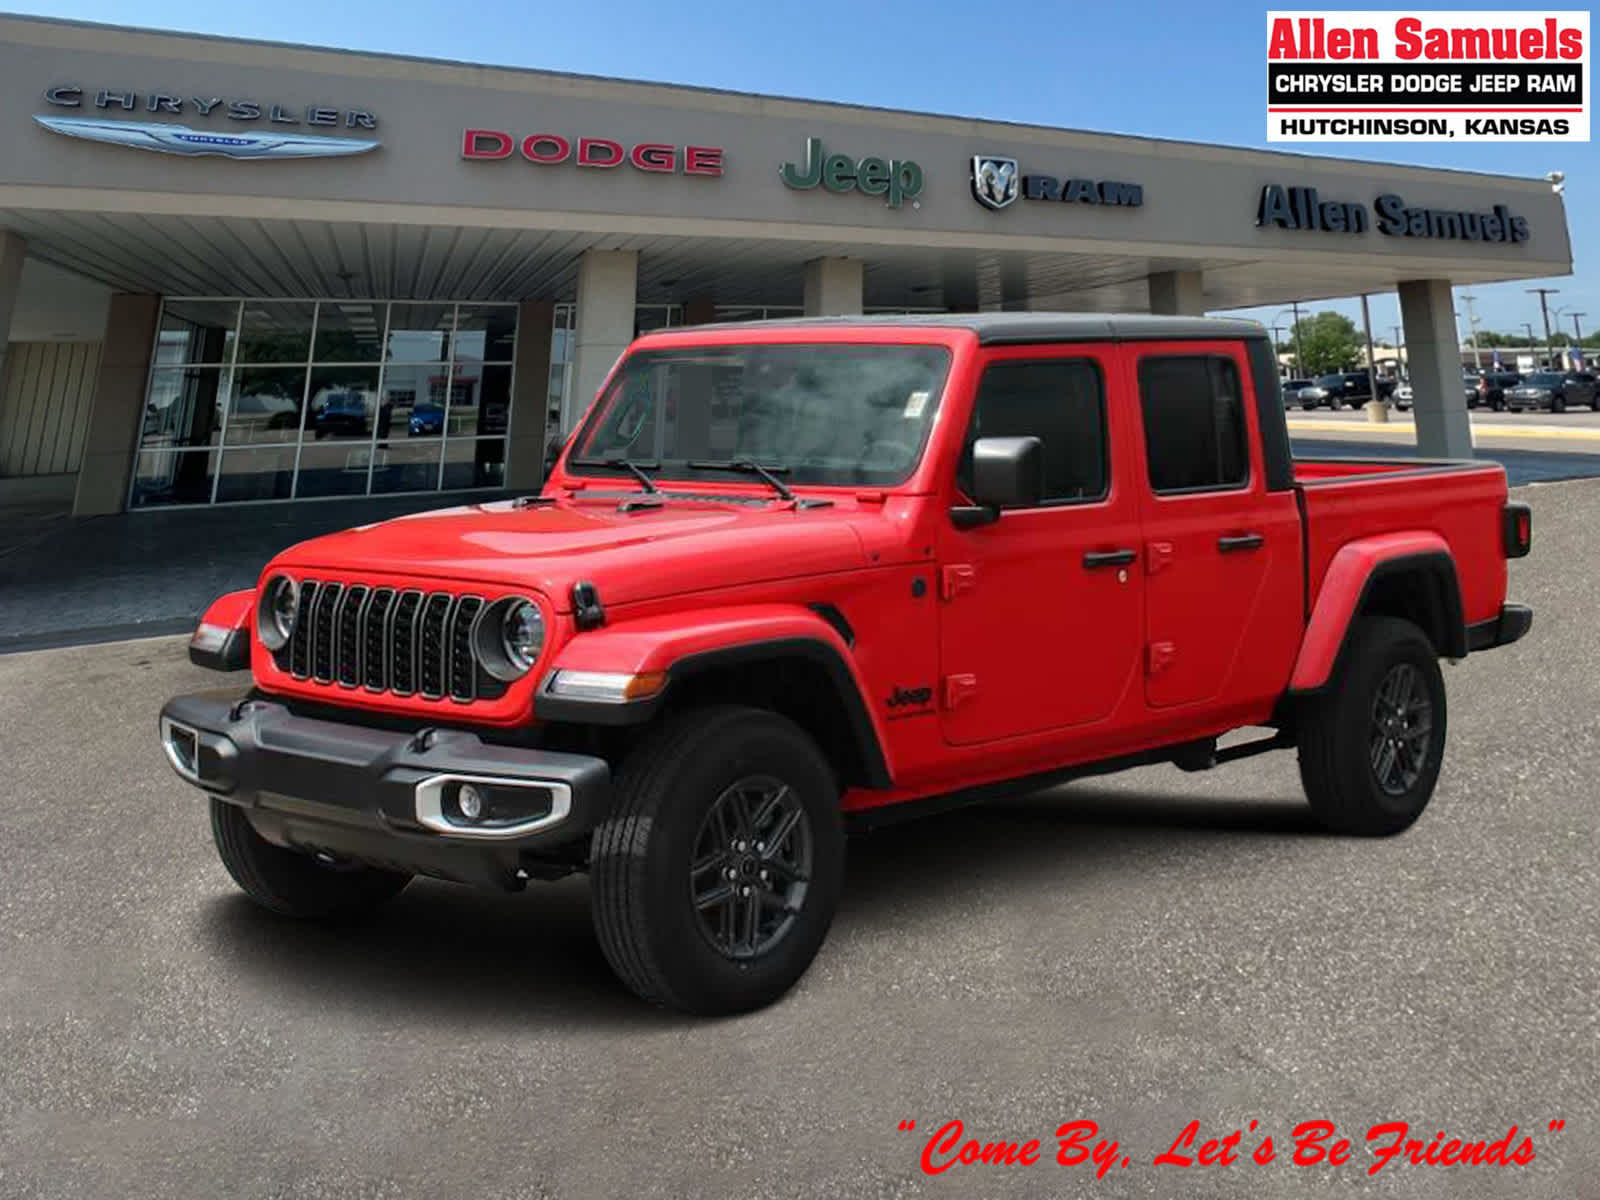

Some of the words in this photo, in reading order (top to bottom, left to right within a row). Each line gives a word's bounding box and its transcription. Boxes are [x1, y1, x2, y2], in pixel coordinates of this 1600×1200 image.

[43, 86, 378, 129] CHRYSLER
[462, 128, 724, 176] DODGE
[779, 137, 924, 209] Jeep
[1022, 175, 1143, 207] RAM
[1256, 184, 1368, 233] Allen
[1374, 194, 1530, 243] Samuels
